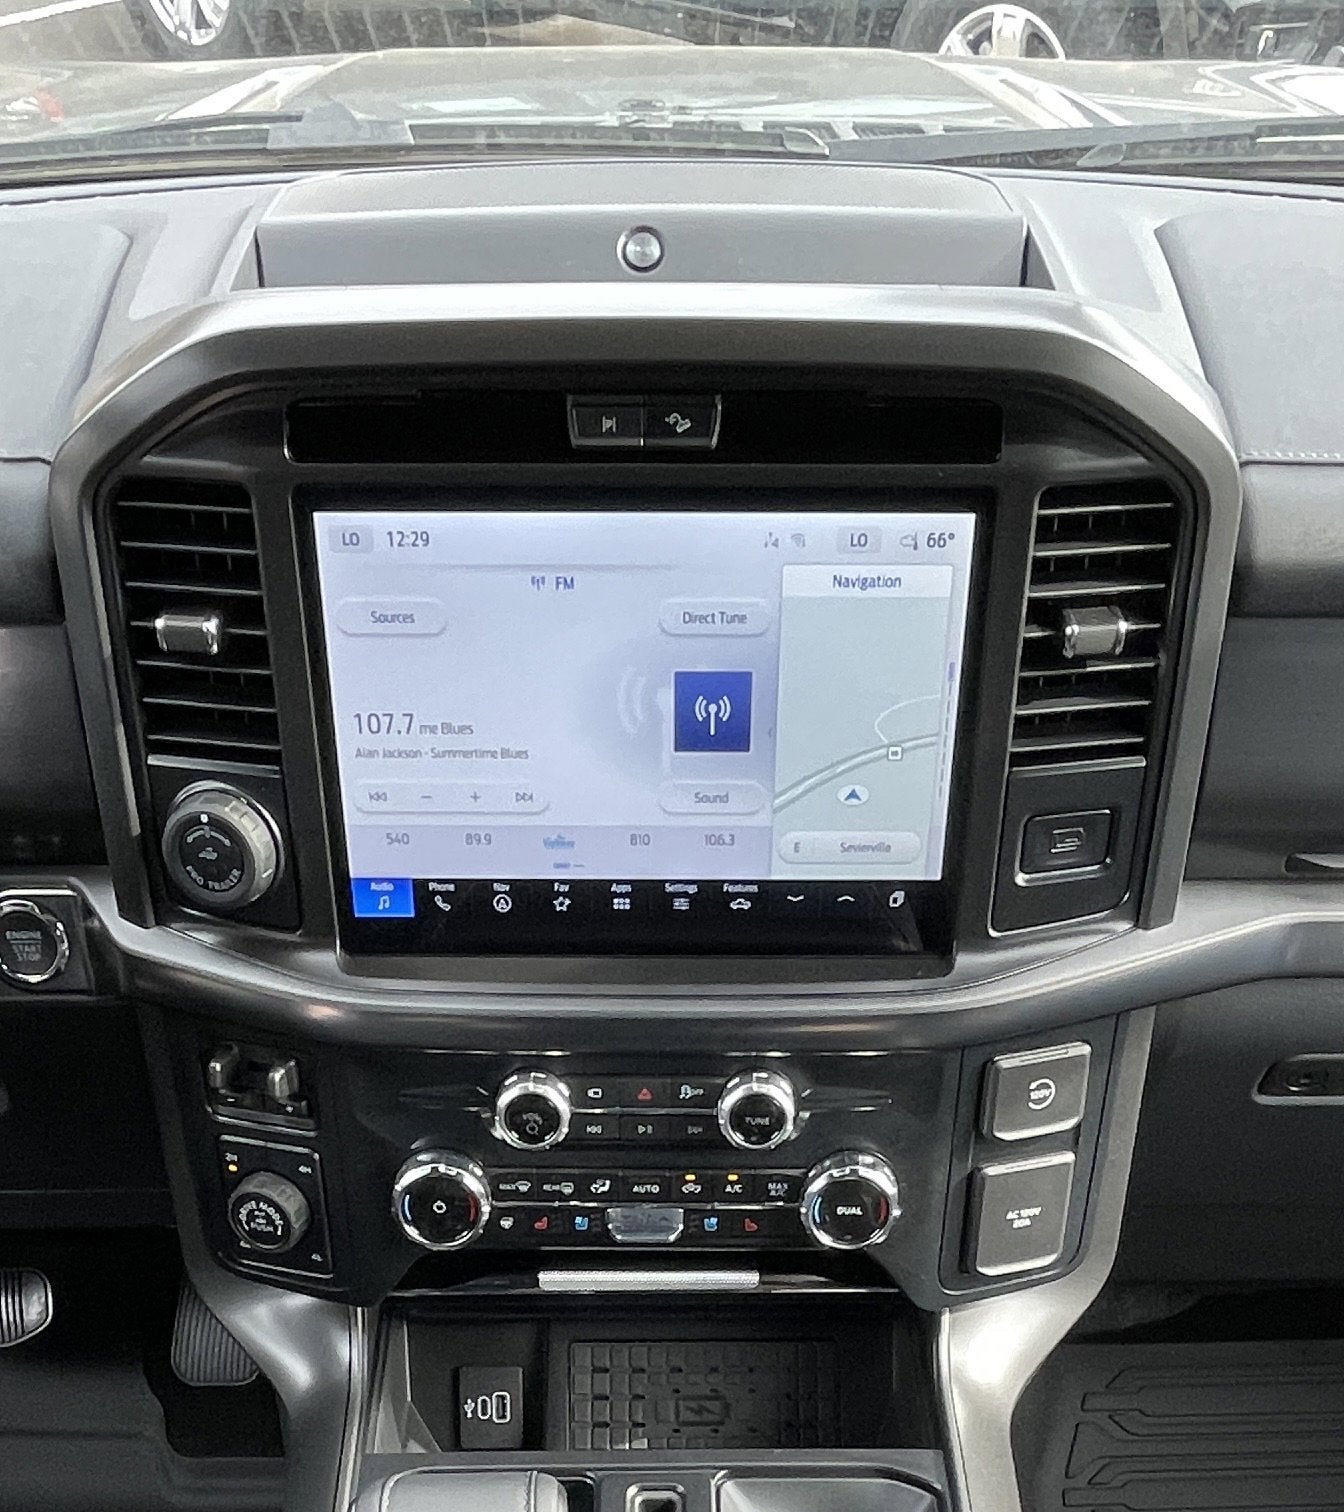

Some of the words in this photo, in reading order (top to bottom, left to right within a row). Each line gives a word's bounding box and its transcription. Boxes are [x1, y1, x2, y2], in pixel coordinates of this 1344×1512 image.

[341, 532, 360, 547] LO
[386, 530, 431, 548] 12:29
[849, 533, 868, 548] LO
[926, 532, 956, 549] 66°
[555, 575, 575, 590] FM
[832, 574, 902, 591] Navigation
[370, 610, 416, 624] Sources
[682, 611, 716, 625] Direct
[719, 611, 748, 625] Tune
[353, 712, 414, 736] 107.7
[419, 724, 438, 735] me
[440, 721, 474, 735] Blues
[355, 747, 380, 759] Alan
[382, 747, 423, 759] Jackson
[430, 747, 498, 760] Summertime
[500, 748, 529, 760] Blues
[694, 791, 730, 804] Sound
[385, 832, 410, 846] 540
[464, 833, 492, 846] 89.9
[629, 833, 651, 846] 810
[793, 841, 802, 854] E
[610, 882, 632, 894] Apps
[632, 1183, 660, 1194] AUTO
[724, 1183, 743, 1194] A/C
[836, 1205, 864, 1216] DUAL
[1006, 1210, 1020, 1220] AC
